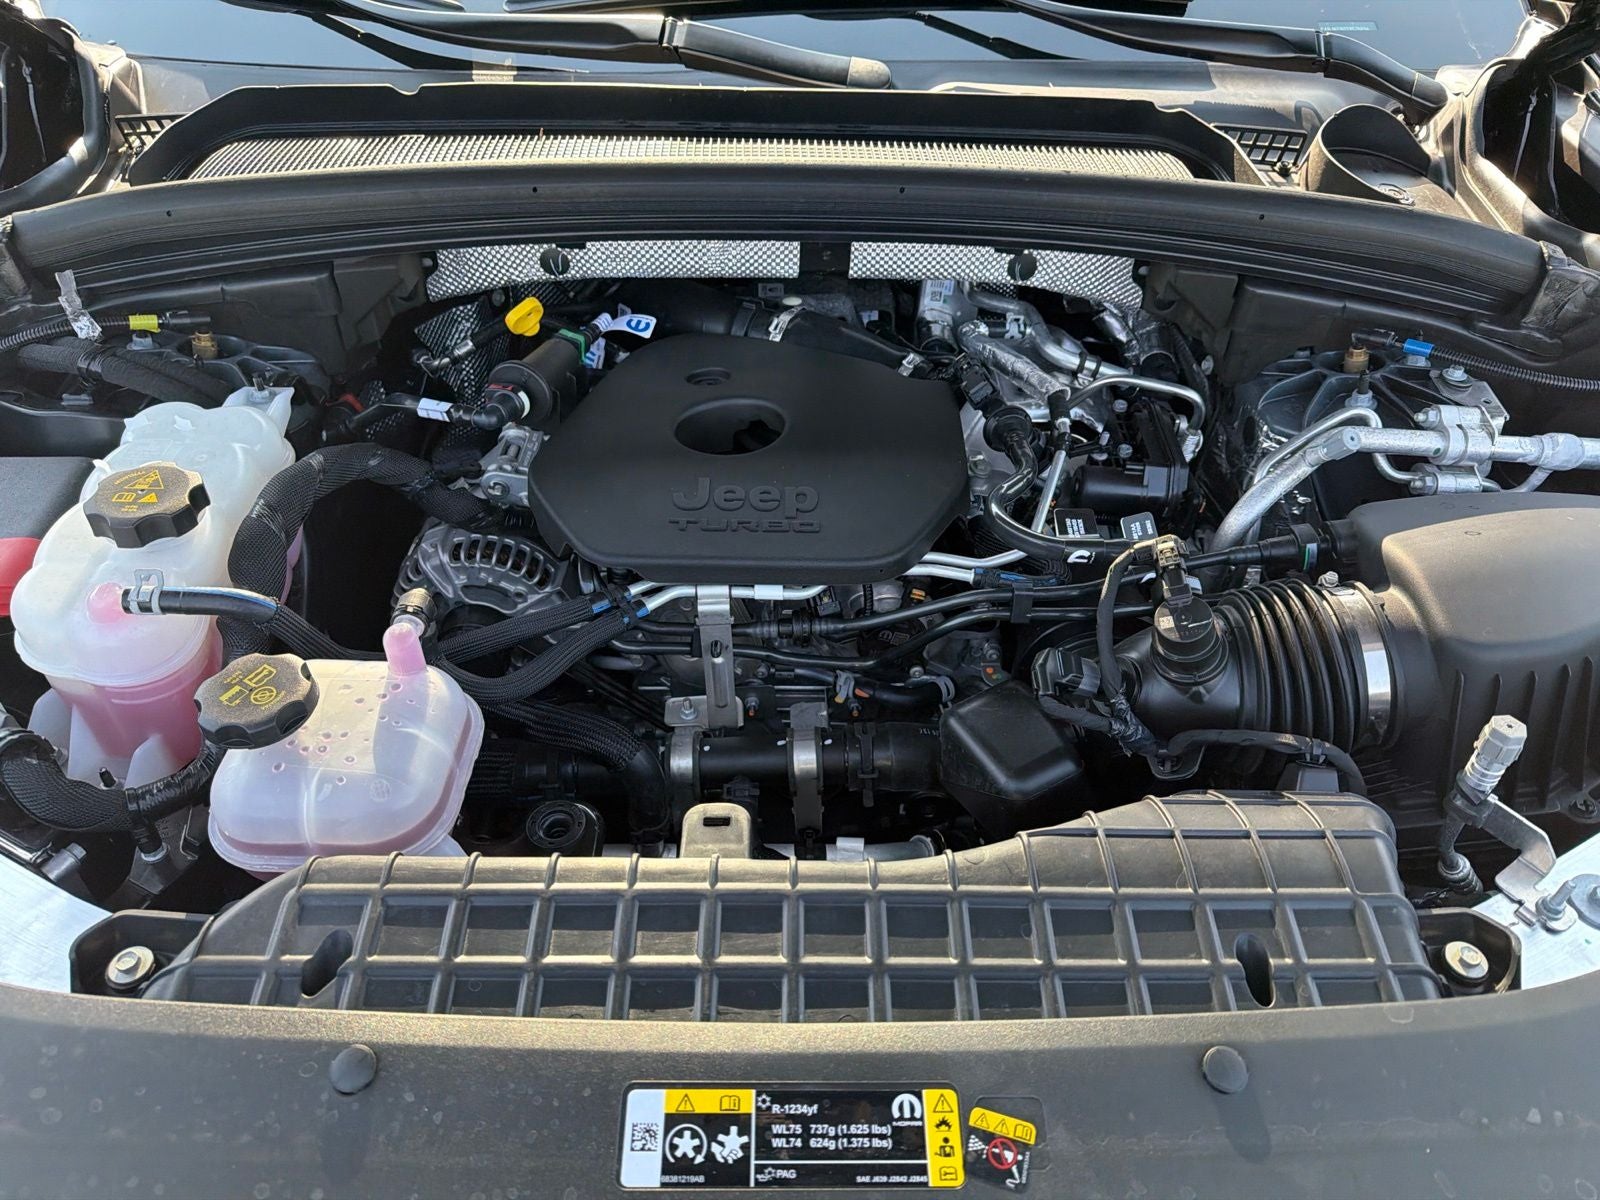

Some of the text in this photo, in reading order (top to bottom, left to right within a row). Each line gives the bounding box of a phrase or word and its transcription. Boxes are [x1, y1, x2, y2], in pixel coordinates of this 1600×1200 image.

[672, 476, 820, 520] Jeep
[669, 518, 822, 533] TURBO
[772, 1104, 818, 1116] R-1234yf
[772, 1124, 892, 1136] WL75 737g (1.625 lbs)
[772, 1138, 893, 1150] WL74 624g (1.375 lbs)
[776, 1169, 797, 1179] PAG
[856, 1175, 871, 1183] SAE
